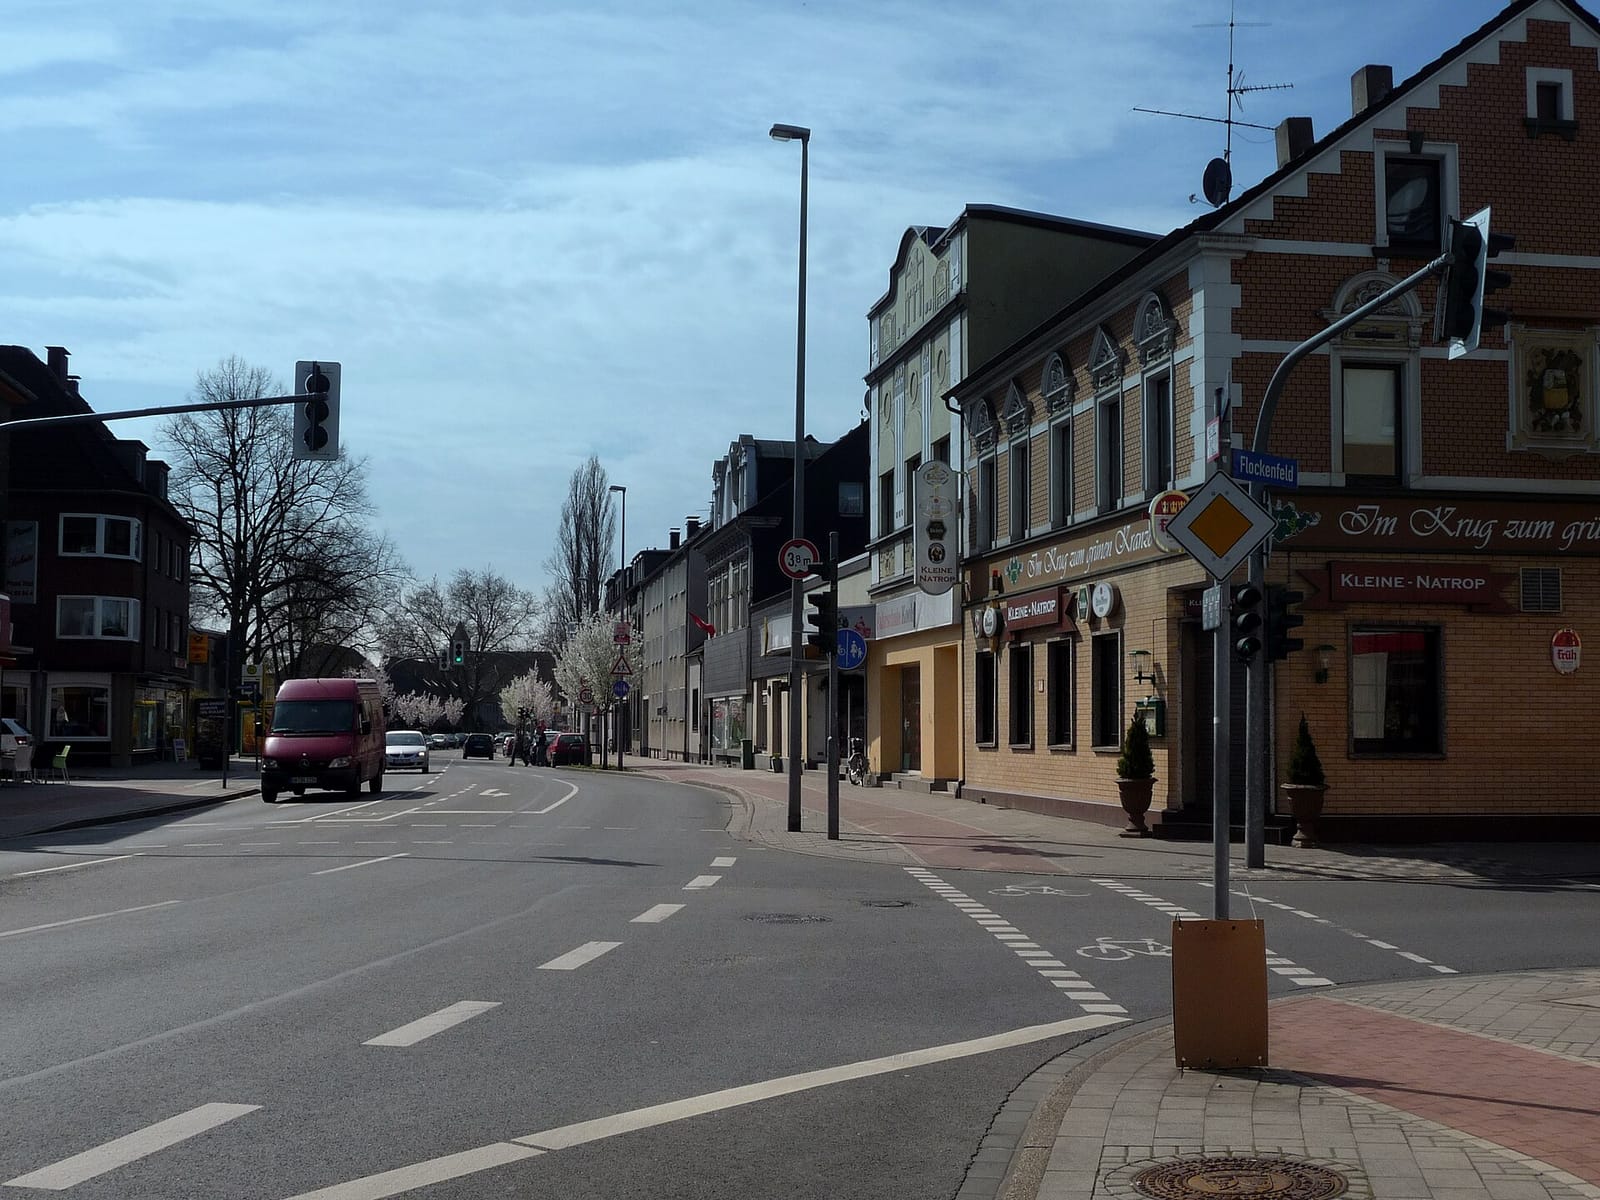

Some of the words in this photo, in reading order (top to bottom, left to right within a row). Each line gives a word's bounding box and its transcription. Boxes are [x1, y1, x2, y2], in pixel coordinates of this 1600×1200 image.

[1239, 455, 1294, 482] Flockenfeld
[1339, 504, 1399, 536] Im
[1410, 506, 1498, 550] Krug
[1502, 519, 1556, 541] zum
[920, 566, 953, 575] KLEINE
[1044, 547, 1069, 580] Krug
[1070, 548, 1085, 568] zum
[919, 575, 957, 584] NATROP
